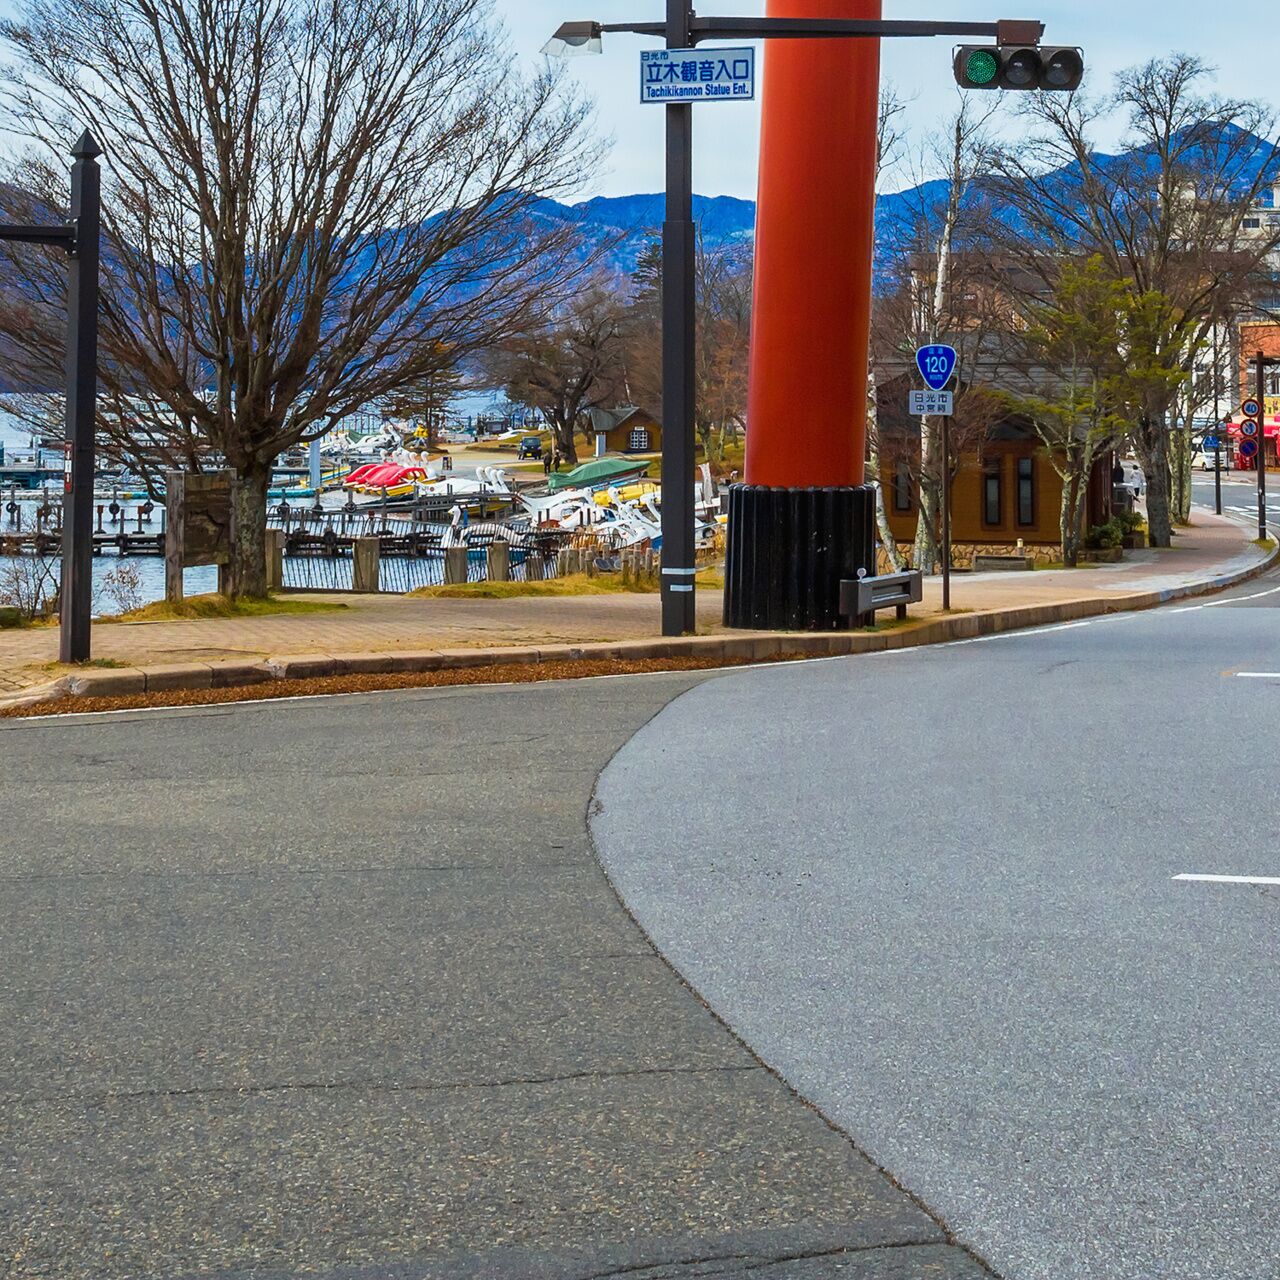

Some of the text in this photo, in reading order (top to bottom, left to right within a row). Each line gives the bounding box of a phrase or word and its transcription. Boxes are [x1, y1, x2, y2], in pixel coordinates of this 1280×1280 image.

[641, 51, 669, 61] 日光市
[646, 59, 749, 82] 立木観音入口
[646, 82, 749, 98] Tachikikannon Statue Ent.
[925, 357, 948, 373] 120
[914, 393, 948, 403] 日光市
[1246, 404, 1256, 413] 40
